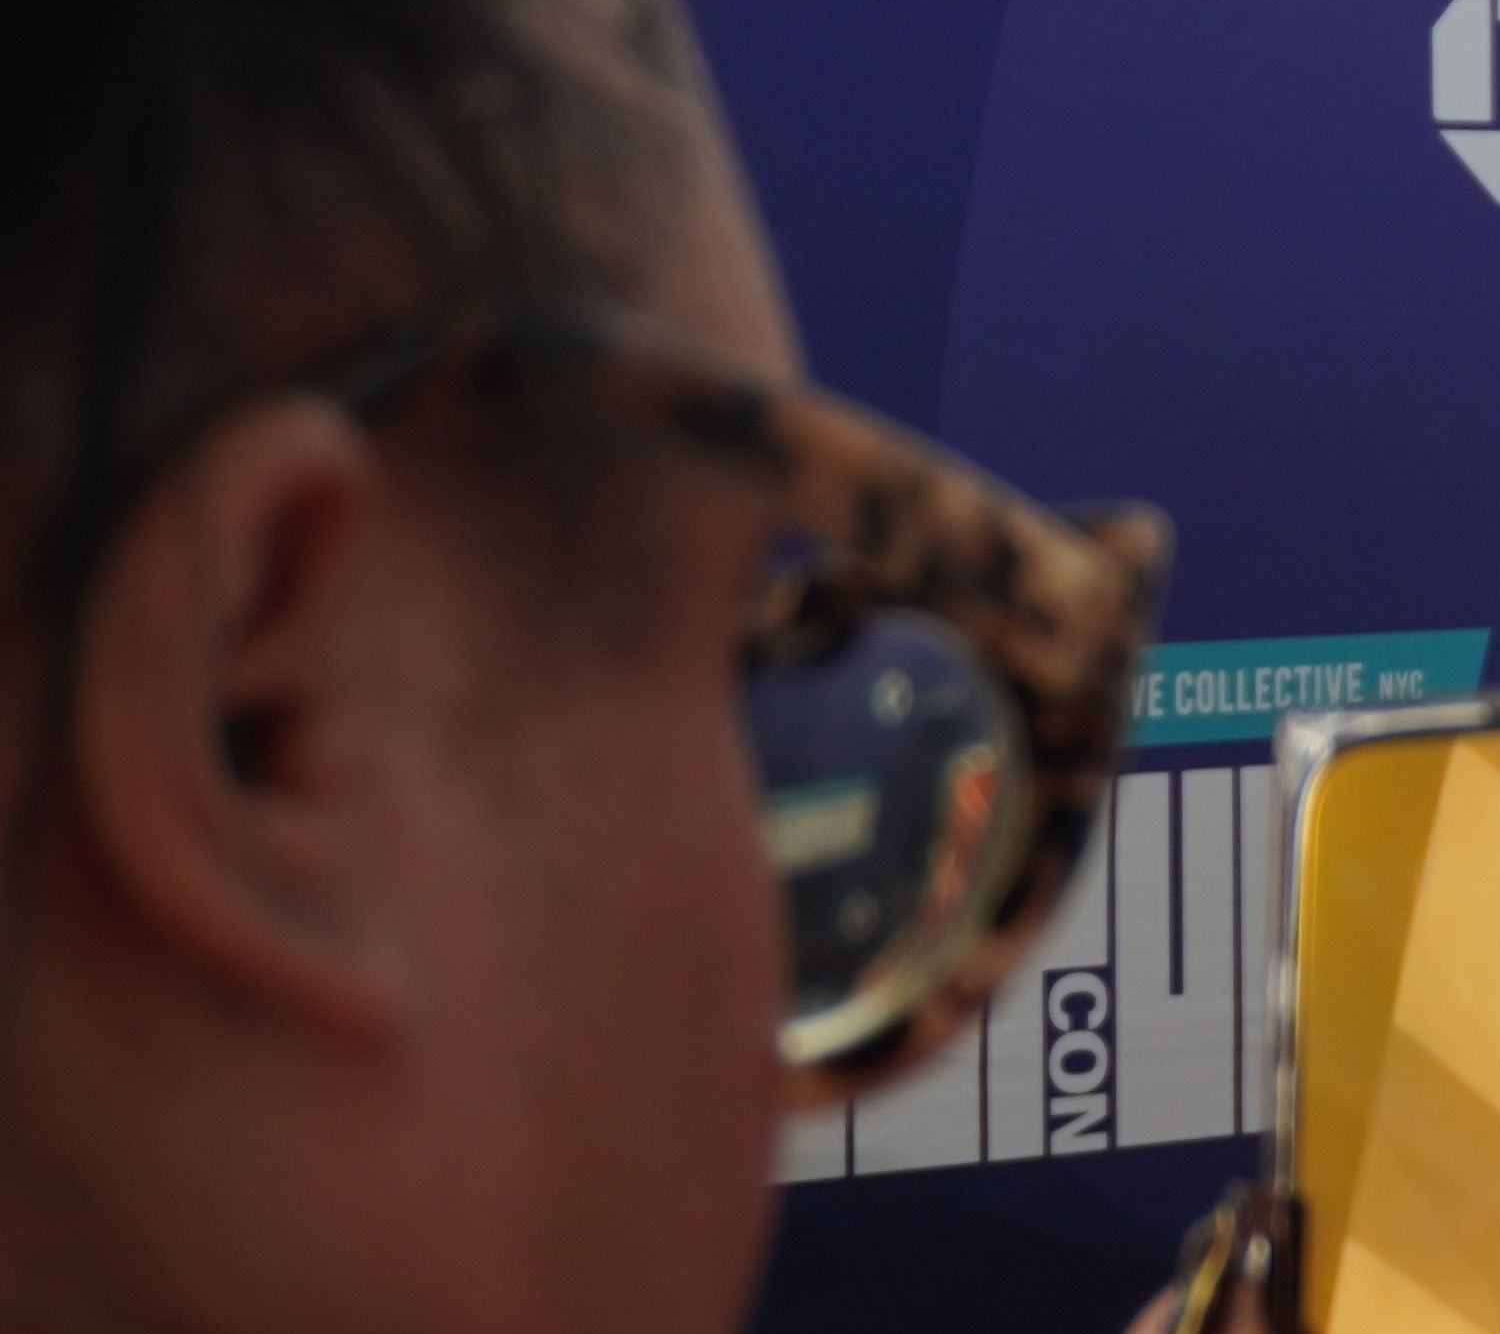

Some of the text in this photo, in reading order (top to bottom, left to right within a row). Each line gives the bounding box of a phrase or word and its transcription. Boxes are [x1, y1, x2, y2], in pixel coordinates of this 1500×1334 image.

[1175, 662, 1364, 715] COLLECTIVE
[1378, 669, 1424, 702] NYC
[1048, 970, 1109, 1155] CON
